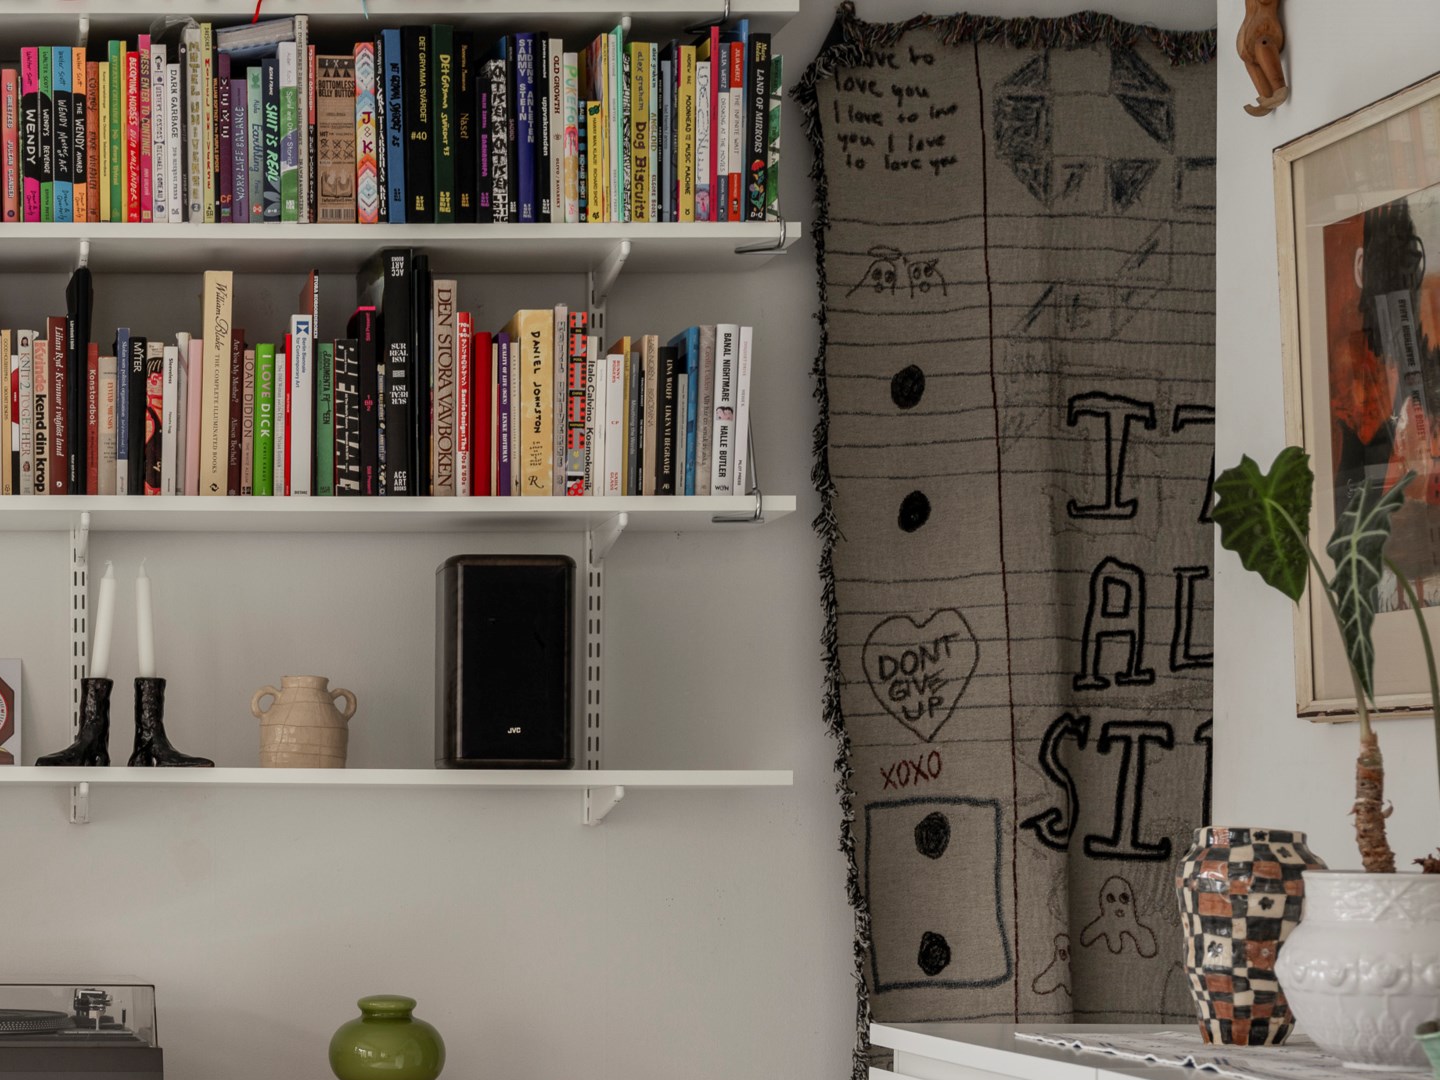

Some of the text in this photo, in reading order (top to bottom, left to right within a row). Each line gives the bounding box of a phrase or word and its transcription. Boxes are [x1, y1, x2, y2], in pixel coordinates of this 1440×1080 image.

[141, 49, 150, 156] PRESS ENTER TO CONTINUE
[834, 66, 929, 107] love you
[266, 102, 277, 131] SHIT
[420, 89, 428, 122] SVÄRDET
[755, 69, 764, 153] LAND OF MIRRORS
[848, 104, 883, 127] love
[26, 109, 36, 164] WENDY
[75, 119, 84, 150] WENDY
[411, 132, 427, 141] #40
[837, 133, 875, 152] you
[267, 150, 278, 182] REAL
[634, 122, 646, 219] Dog Biscuits
[214, 282, 228, 350] William Blake
[55, 327, 63, 351] Lilian
[55, 353, 63, 368] Ryd
[133, 342, 144, 372] MYTER
[244, 355, 254, 438] JOAN DIDION
[261, 364, 271, 398] LOVE
[438, 289, 454, 490] DEN STORA VÄVBOKEN
[531, 331, 541, 433] DANIEL JOHNSTON
[721, 359, 731, 402] NIGHTMARE
[21, 352, 31, 456] KNIT 2 TOGETHER
[34, 342, 46, 492] Kvinde kend din krop
[260, 403, 270, 437] DICK
[587, 385, 595, 421] Calvino
[53, 412, 63, 437] väglöst
[720, 426, 728, 447] HALLE
[56, 438, 64, 456] land
[584, 428, 594, 491] Kosmokomik
[718, 450, 727, 477] BUTLER
[878, 632, 959, 681] DONT
[888, 669, 949, 701] GIVE
[900, 696, 943, 721] UP
[881, 750, 943, 789] XOXO
